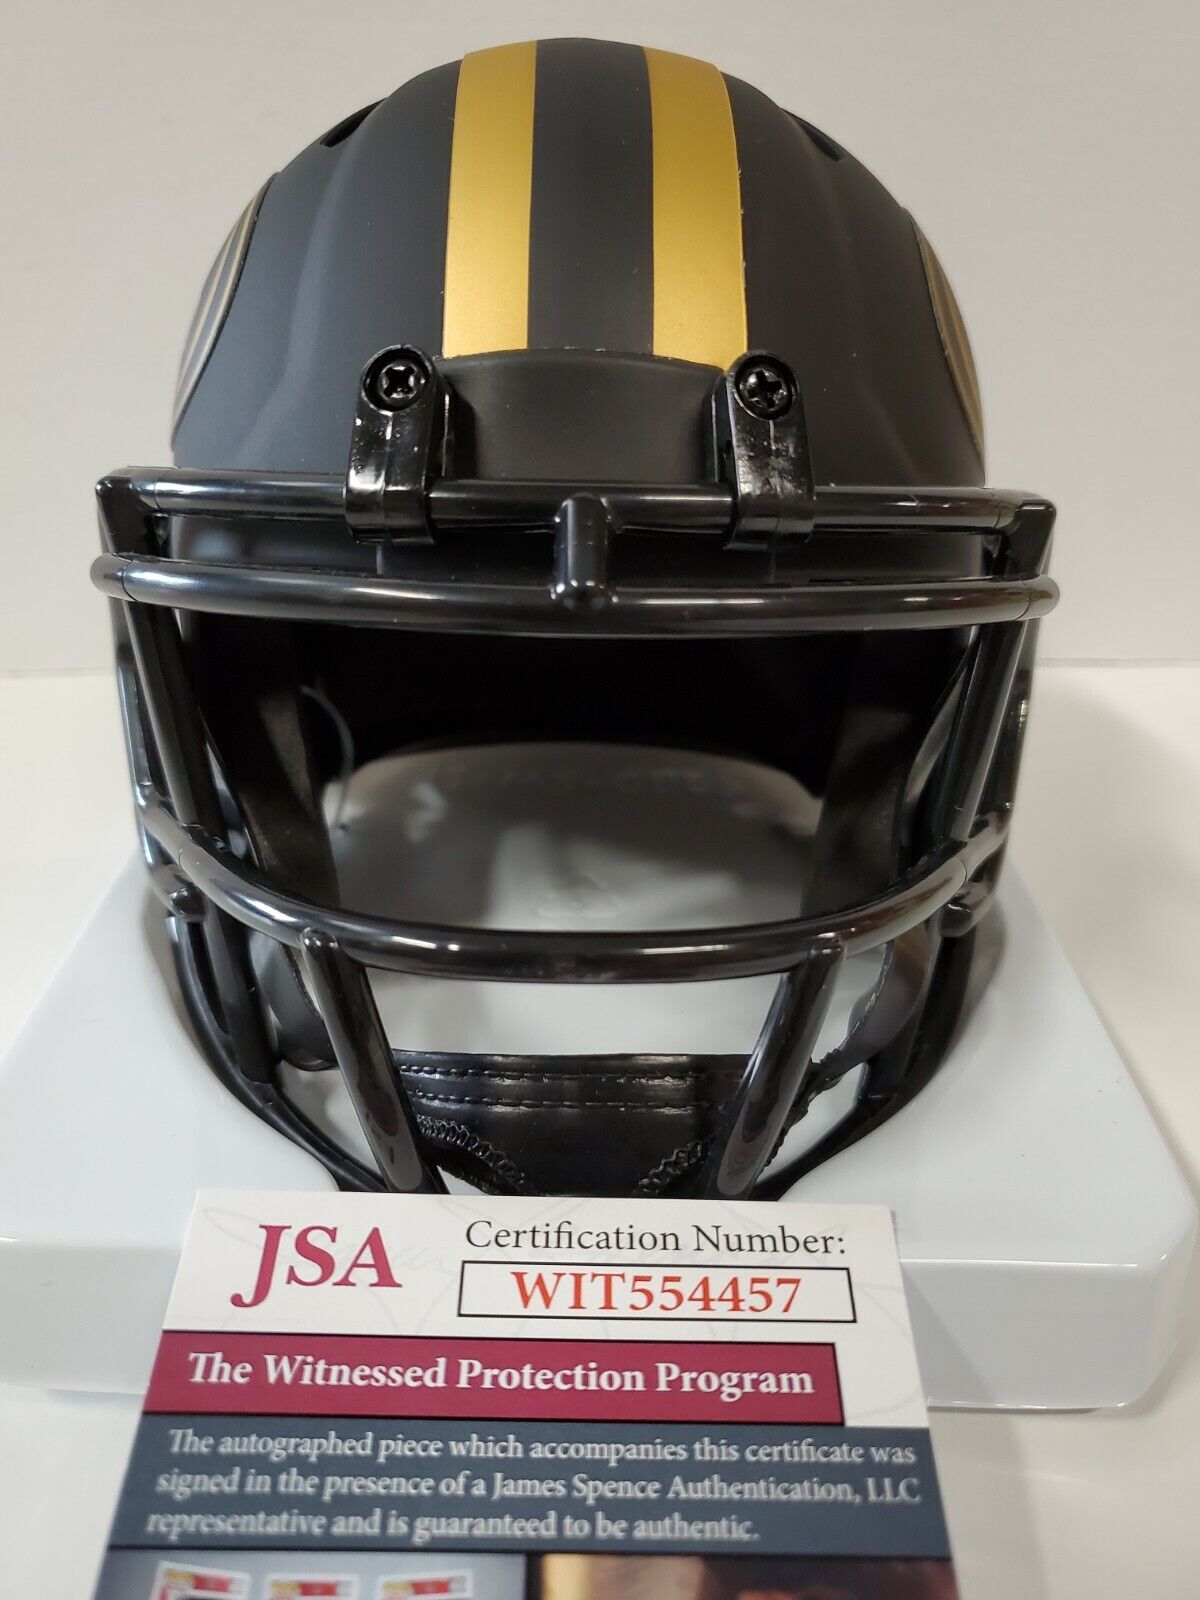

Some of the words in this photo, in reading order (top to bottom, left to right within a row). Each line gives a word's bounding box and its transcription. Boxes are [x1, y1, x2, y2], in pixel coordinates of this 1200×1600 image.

[466, 1219, 681, 1253] Certification
[693, 1224, 846, 1255] Number:
[230, 1223, 402, 1308] JSA
[511, 1270, 801, 1314] WIT554457
[188, 1352, 252, 1384] The
[264, 1354, 446, 1388] Witnessed
[456, 1358, 646, 1391] Protection
[656, 1362, 814, 1402] Program
[168, 1428, 214, 1455] The
[218, 1431, 373, 1463] autographed
[377, 1434, 442, 1464] piece
[449, 1434, 523, 1458] which
[529, 1438, 687, 1467] accompanies
[693, 1438, 738, 1463] this
[744, 1439, 864, 1464] certificate
[869, 1443, 918, 1465] was
[156, 1468, 240, 1500] signed
[245, 1468, 271, 1495] in
[279, 1469, 319, 1496] the
[324, 1474, 435, 1502] presence
[439, 1470, 473, 1497] of
[472, 1480, 487, 1498] a
[491, 1472, 566, 1500] James
[572, 1473, 662, 1504] Spence
[668, 1474, 860, 1504] Authentication,
[867, 1477, 922, 1502] LLC
[146, 1510, 326, 1541] representative
[331, 1508, 381, 1537] and
[387, 1510, 408, 1537] is
[413, 1512, 558, 1544] guaranteed
[563, 1516, 590, 1539] to
[595, 1512, 628, 1540] be
[632, 1513, 759, 1540] authentic.
